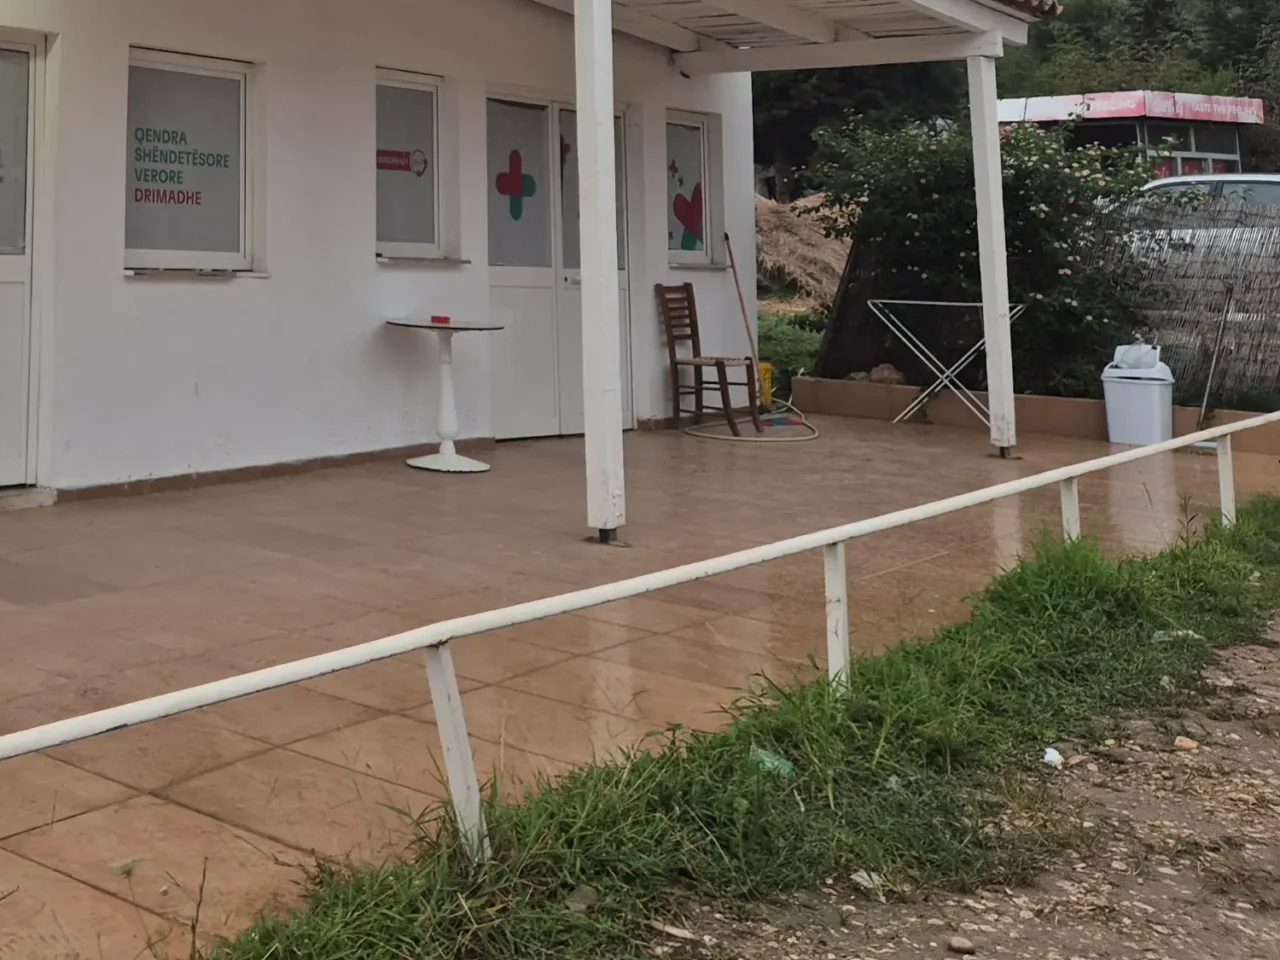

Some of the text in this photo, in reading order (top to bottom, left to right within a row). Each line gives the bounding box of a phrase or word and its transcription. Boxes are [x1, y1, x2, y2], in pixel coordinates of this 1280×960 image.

[134, 127, 187, 145] QENDRA
[134, 146, 230, 168] SHËNDETËSORE
[134, 168, 183, 184] VERORE
[134, 188, 202, 205] DRIMADHE
